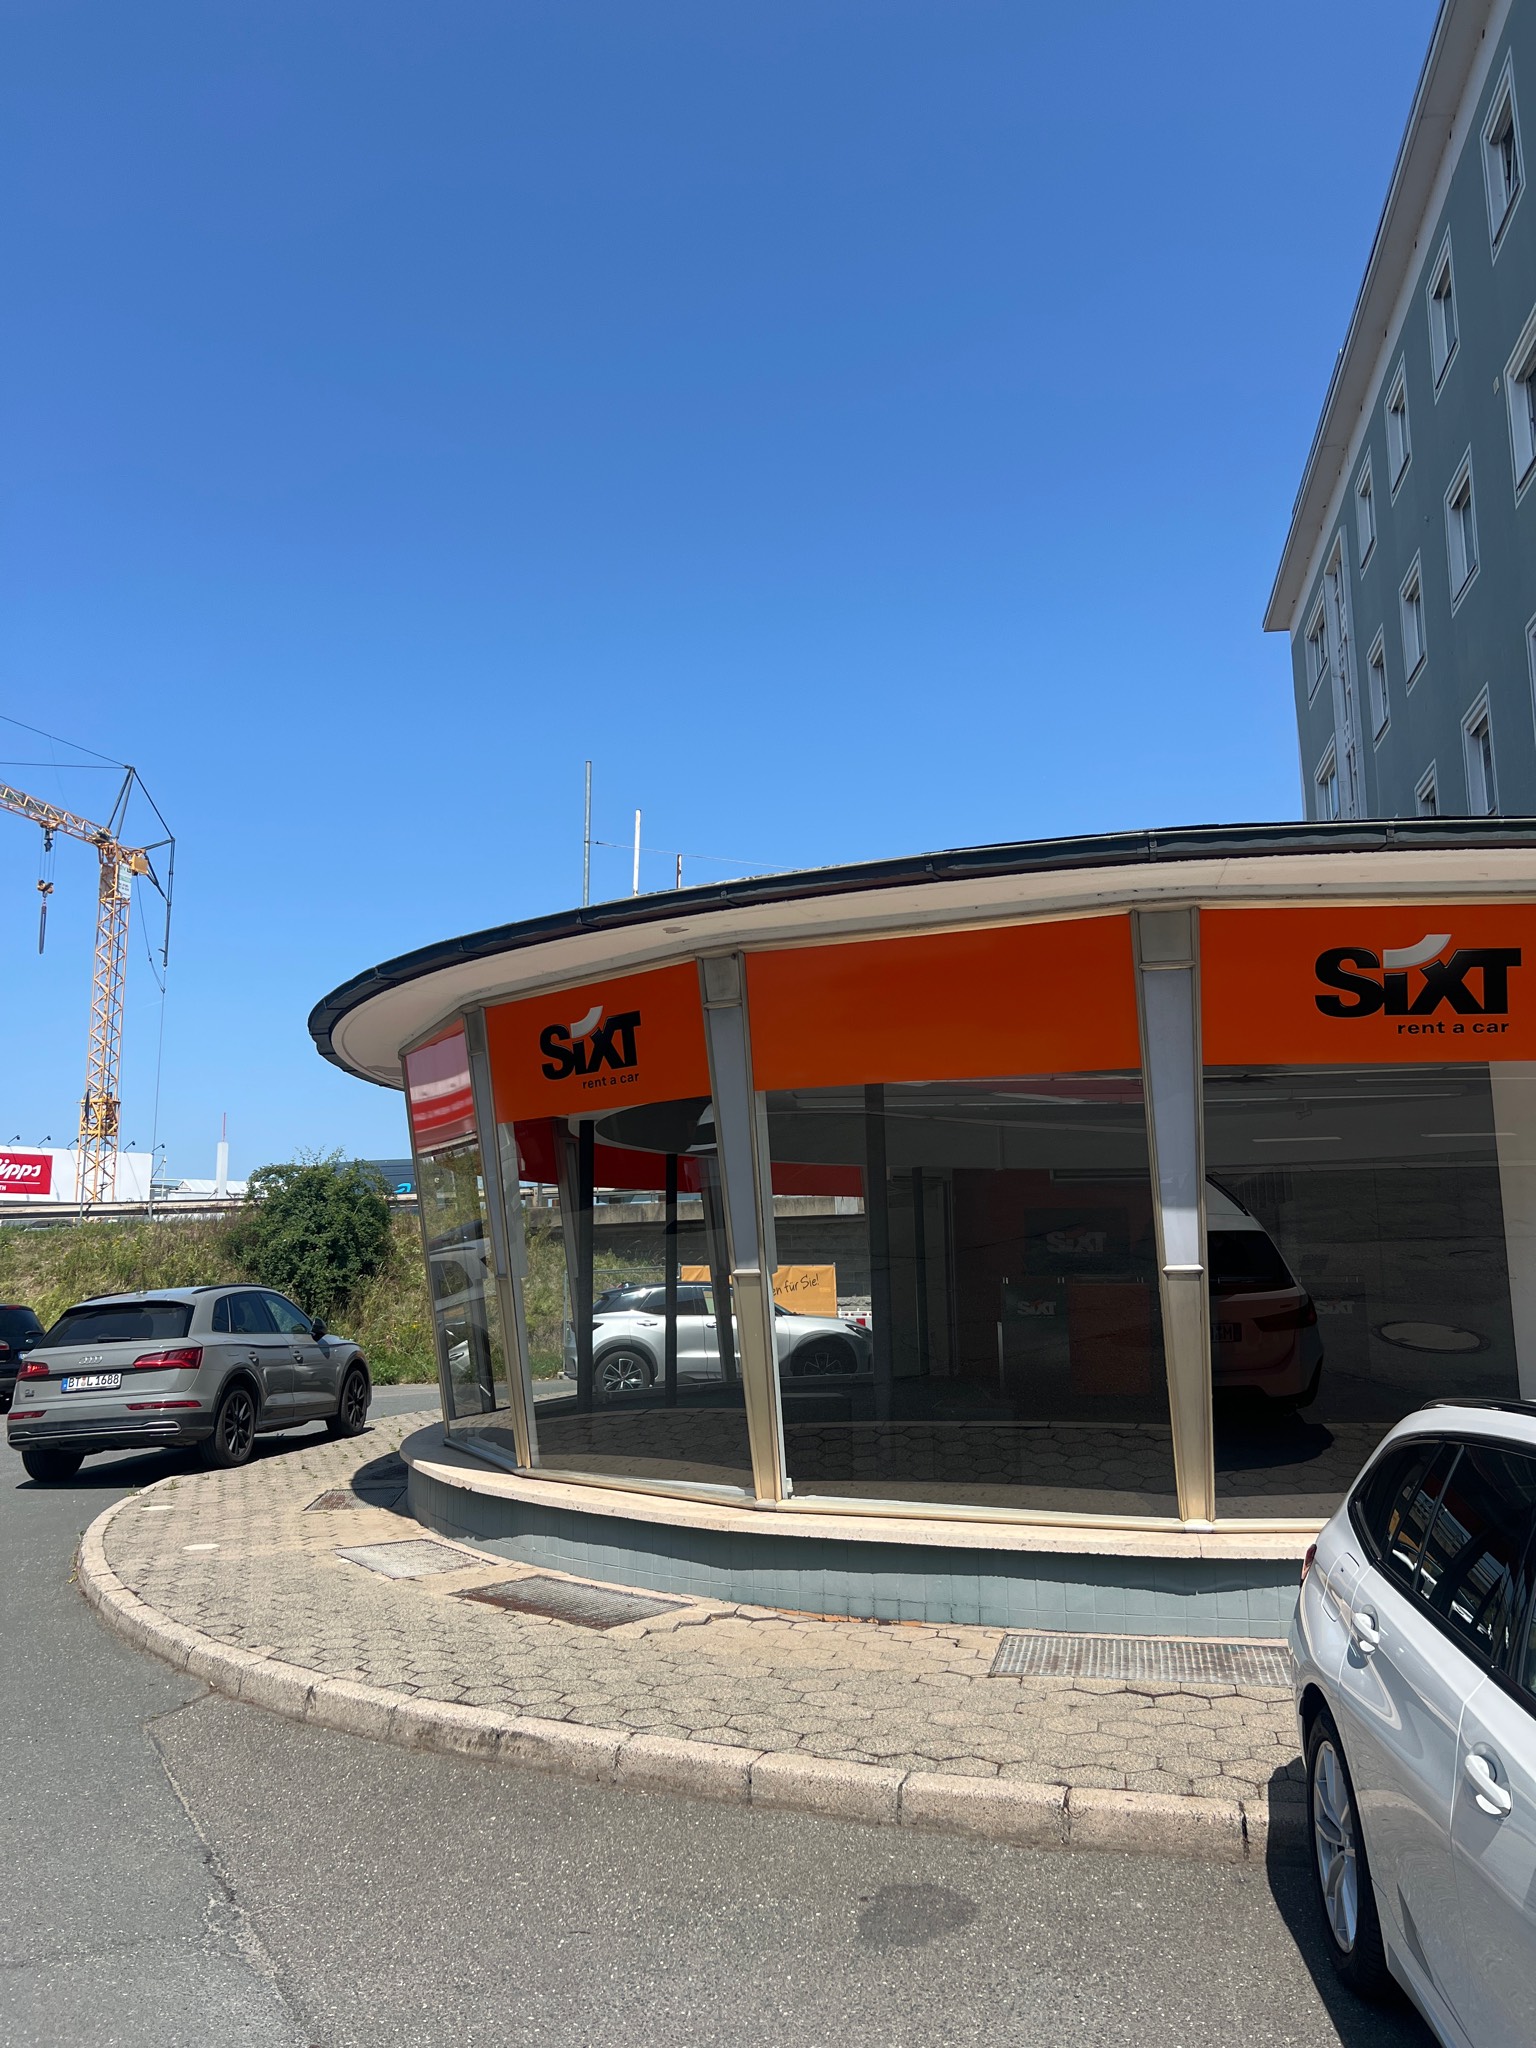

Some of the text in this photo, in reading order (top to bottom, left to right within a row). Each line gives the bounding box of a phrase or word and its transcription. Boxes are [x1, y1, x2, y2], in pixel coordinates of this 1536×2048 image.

[1397, 1021, 1509, 1034] rent a car
[582, 1073, 639, 1089] rent a car
[784, 1280, 798, 1293] für
[800, 1273, 820, 1290] Sie!
